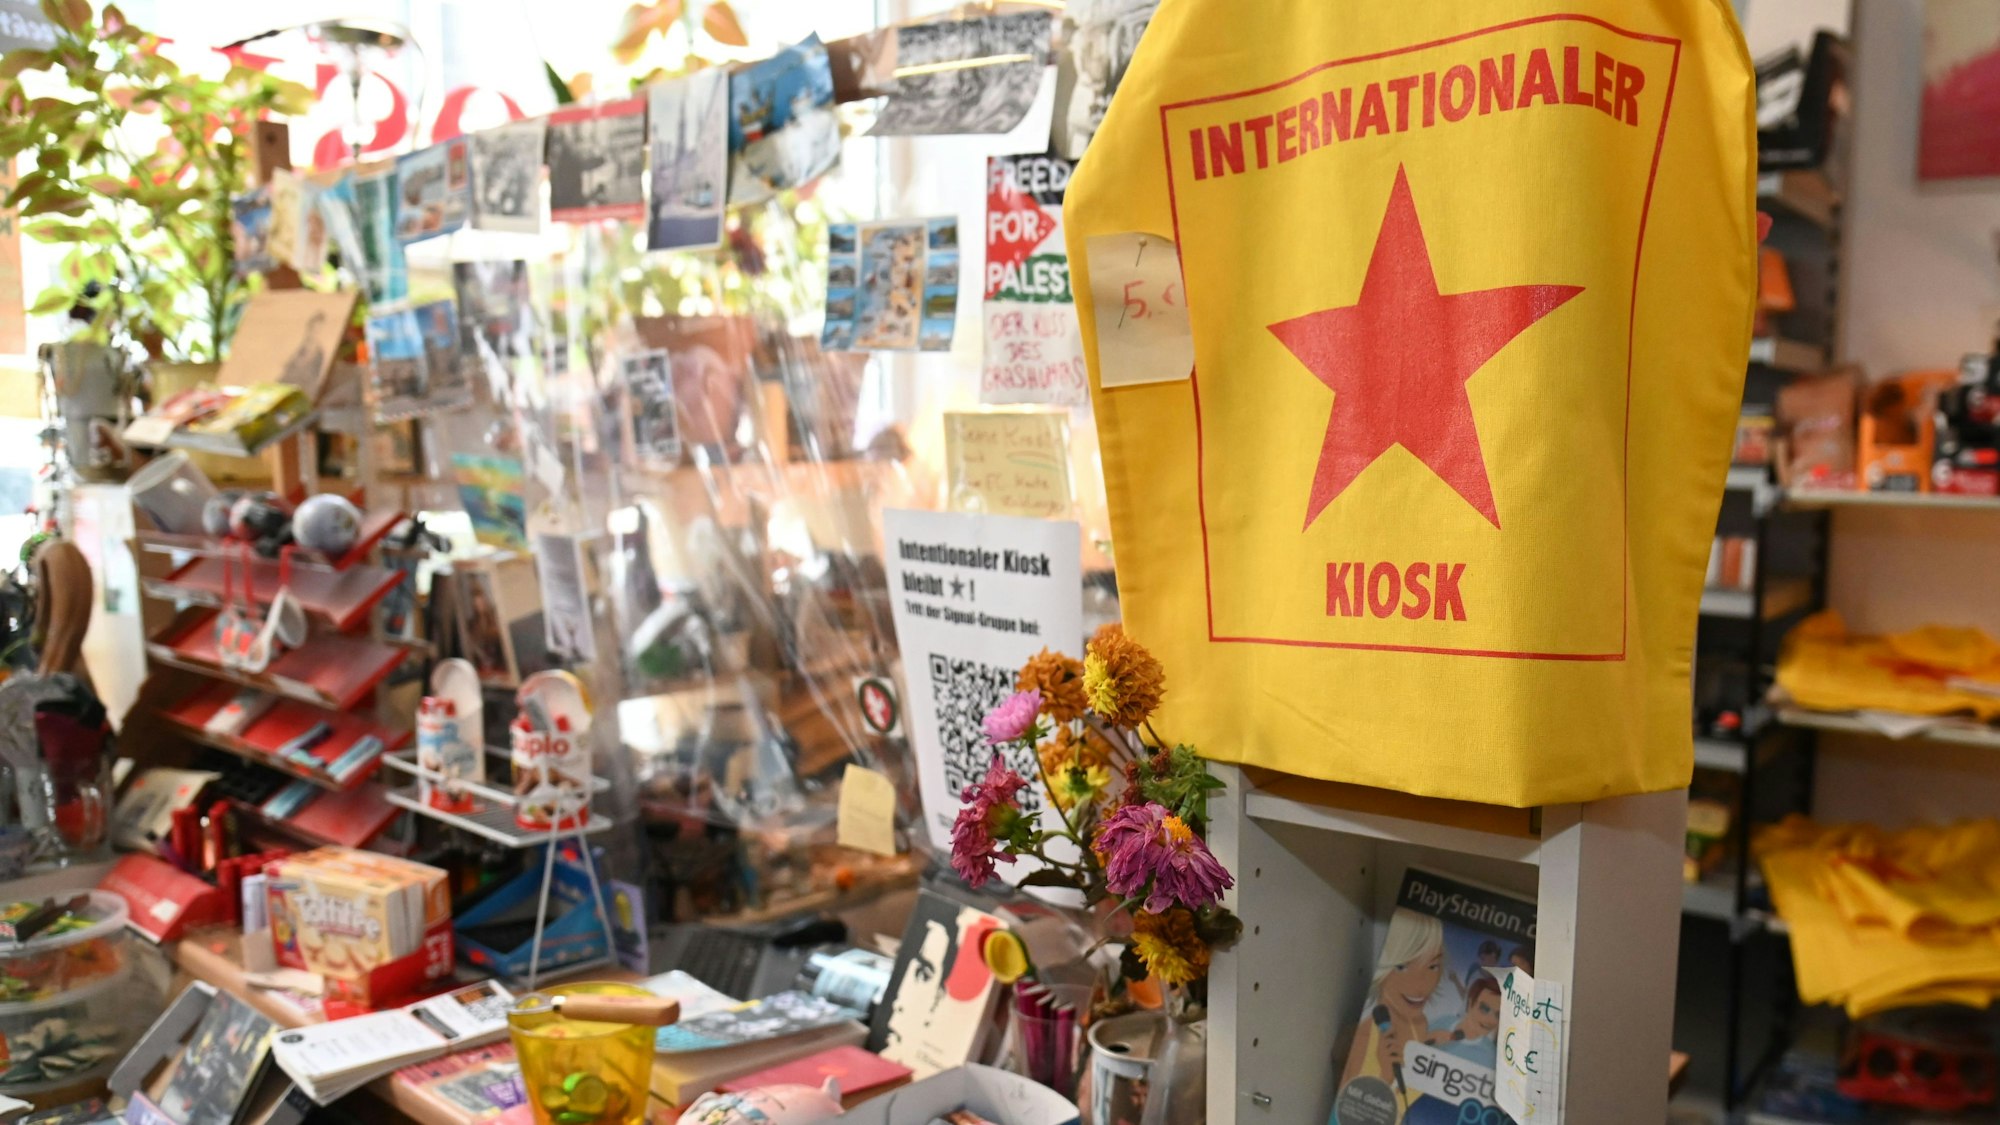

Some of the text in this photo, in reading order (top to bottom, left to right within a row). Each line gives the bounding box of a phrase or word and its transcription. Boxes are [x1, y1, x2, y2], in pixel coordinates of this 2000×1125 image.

[1189, 46, 1645, 181] INTERNATIONALER
[899, 539, 1051, 577] Intentionaler Kiosk
[902, 571, 943, 596] bleibt
[1326, 562, 1467, 621] KIOSK
[926, 605, 941, 619] der
[944, 606, 1017, 632] Signal-Gruppe
[1407, 880, 1521, 933] PlayStation
[1503, 972, 1562, 1023] Angebot
[1412, 1053, 1496, 1099] singst
